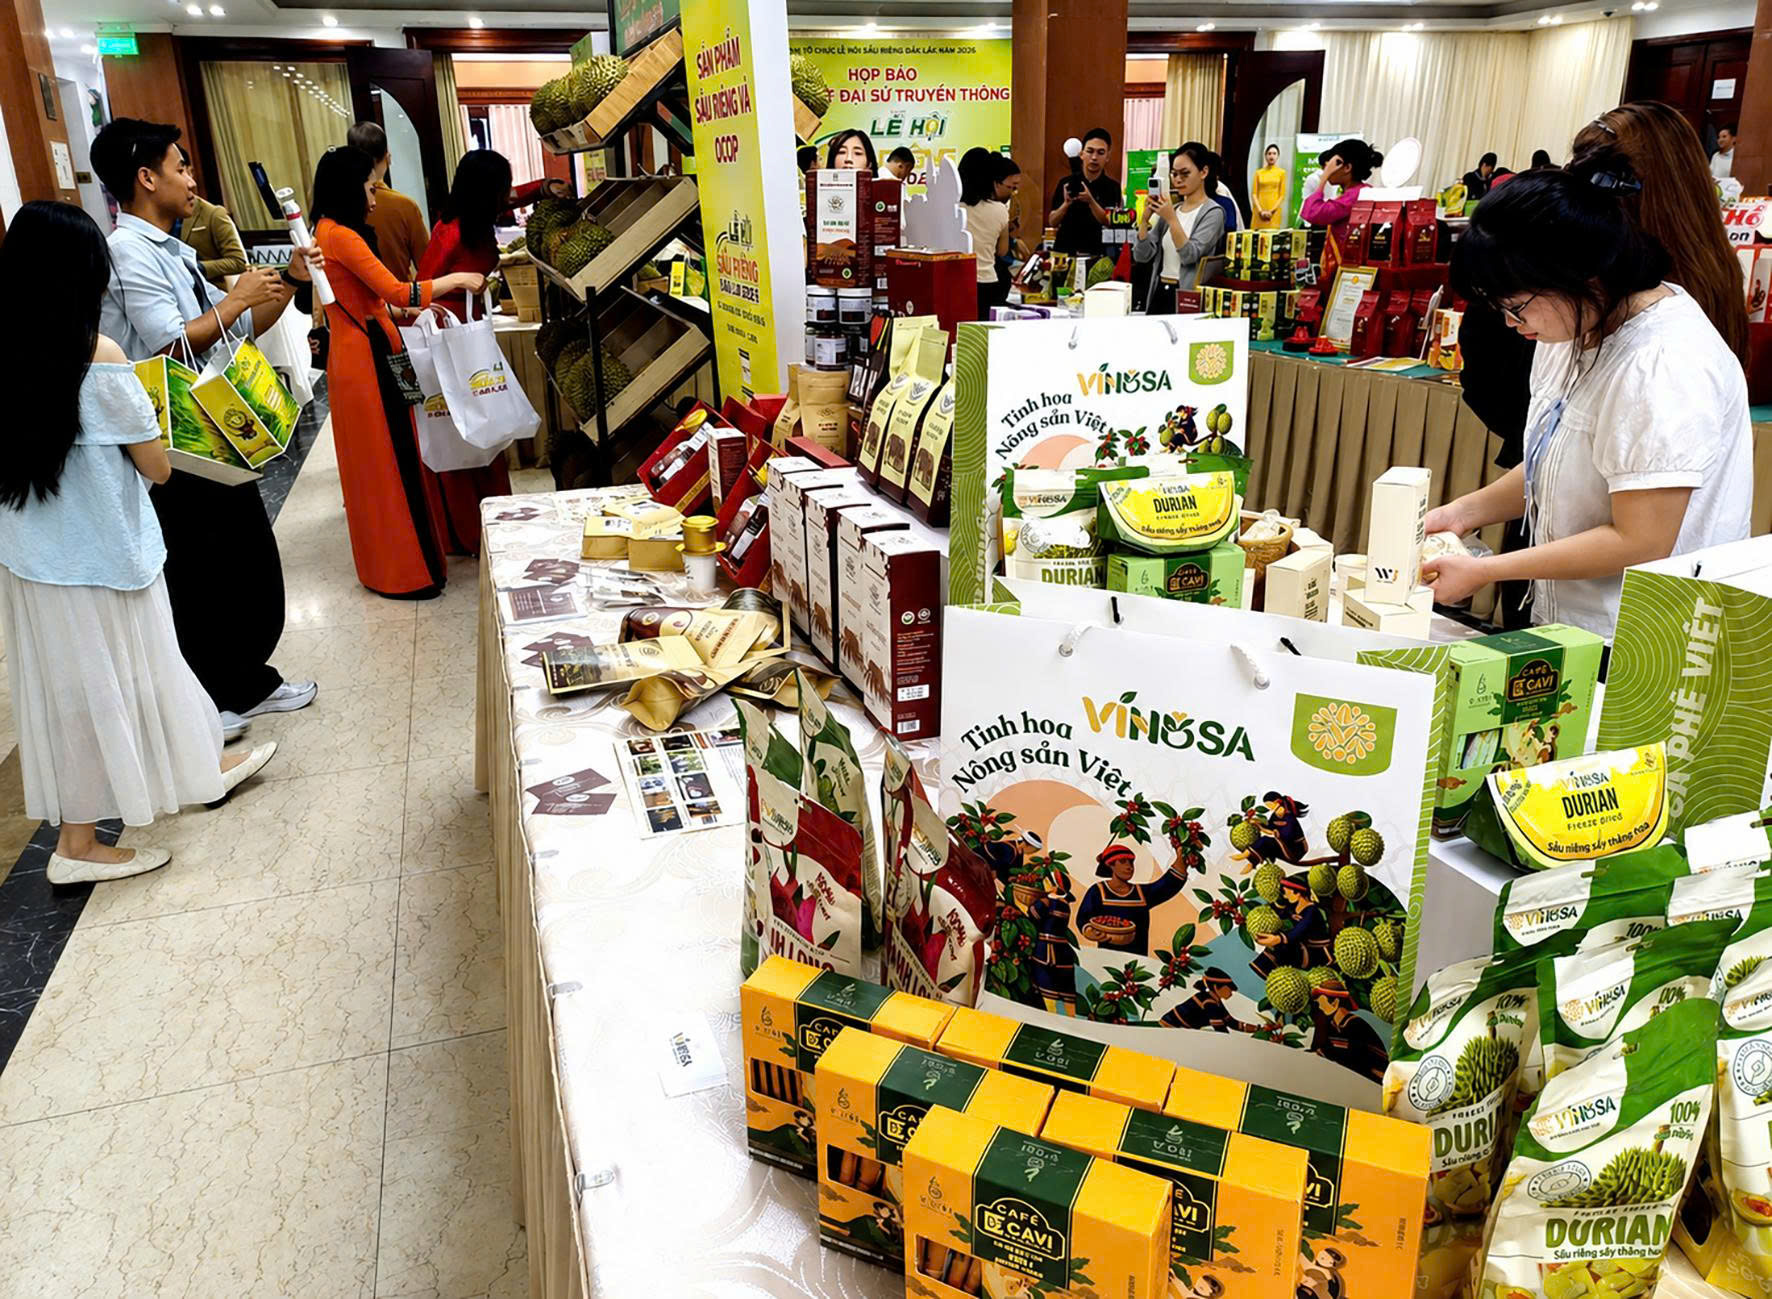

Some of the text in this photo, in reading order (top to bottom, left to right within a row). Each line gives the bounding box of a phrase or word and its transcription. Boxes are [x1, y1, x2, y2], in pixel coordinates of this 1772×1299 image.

[848, 68, 880, 84] HỌP
[960, 84, 1010, 101] THÔNG
[714, 134, 739, 163] OCOP
[1001, 392, 1072, 429] Tinh hoa
[996, 409, 1108, 461] Nông sản Việt
[1153, 495, 1198, 514] DURIAN
[1681, 596, 1725, 678] VIỆT
[1526, 676, 1555, 692] CAVI
[960, 710, 1072, 753] Tinh hoa
[1668, 687, 1708, 763] PHÊ
[951, 748, 1017, 793] Nông
[1020, 740, 1070, 768] sản
[1078, 749, 1133, 797] Việt
[1562, 787, 1620, 819] DURIAN
[996, 1203, 1040, 1227] CAFÉ
[1006, 1221, 1054, 1250] CAVI
[1545, 1213, 1673, 1248] DURIAN
[1573, 1242, 1598, 1260] riêng
